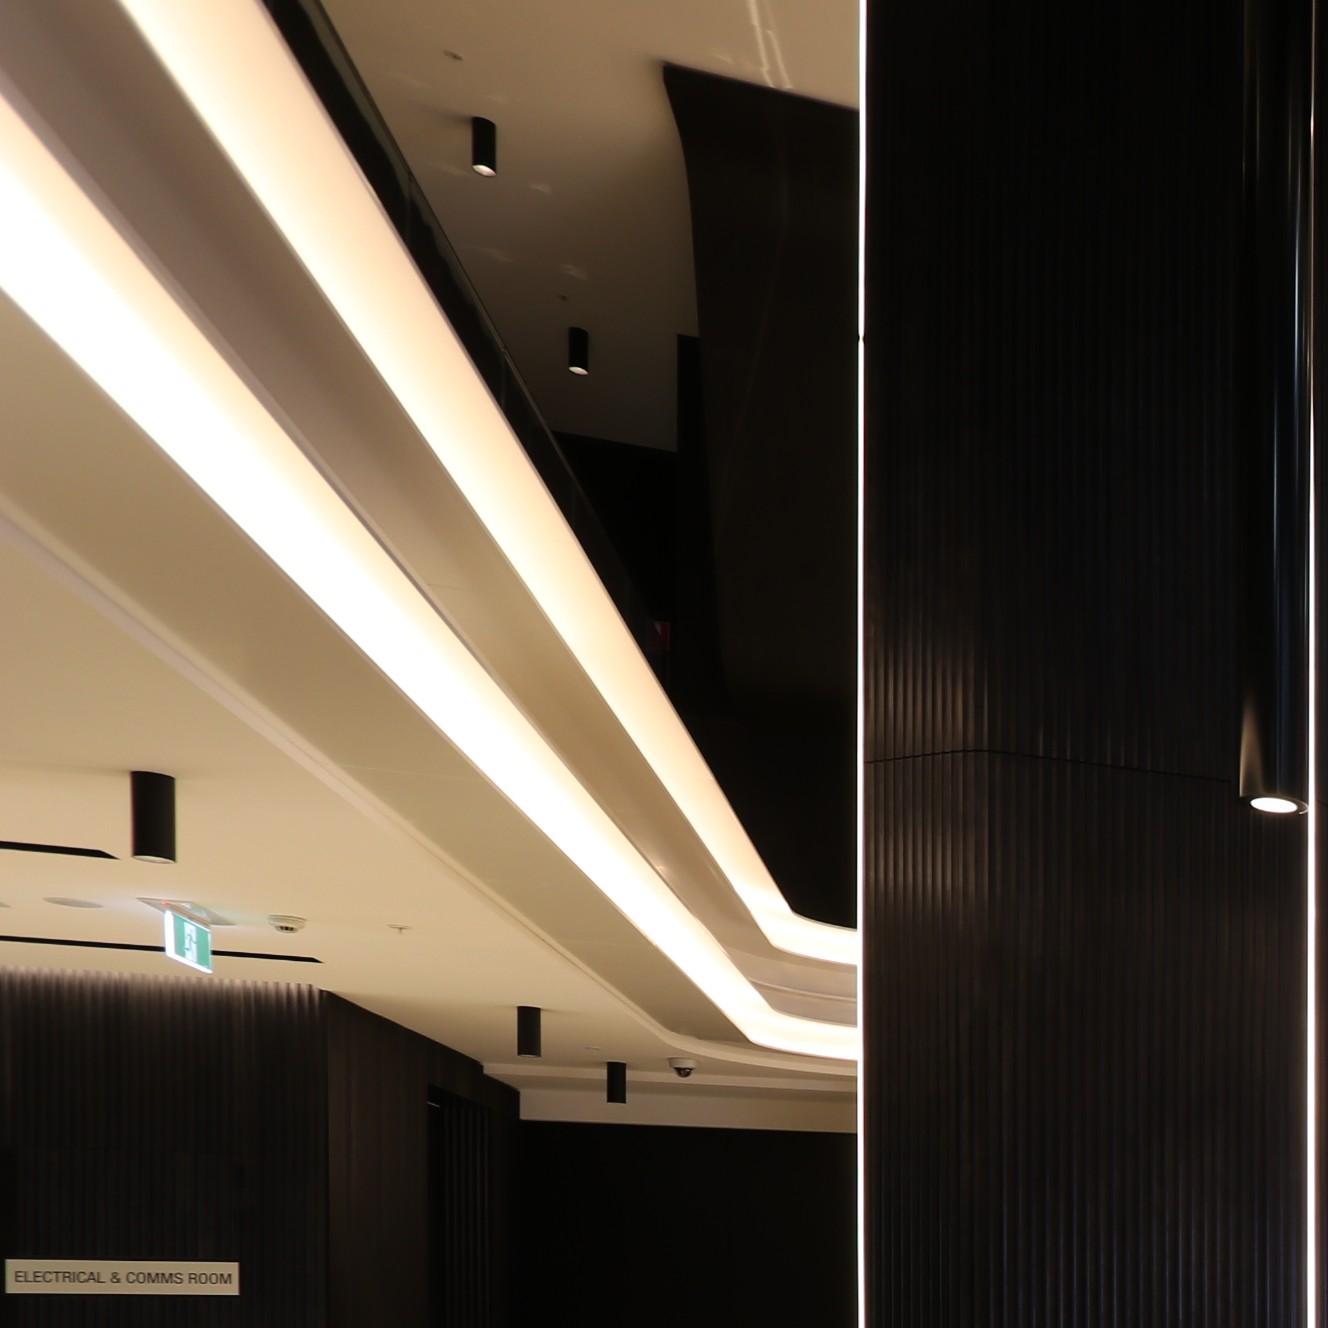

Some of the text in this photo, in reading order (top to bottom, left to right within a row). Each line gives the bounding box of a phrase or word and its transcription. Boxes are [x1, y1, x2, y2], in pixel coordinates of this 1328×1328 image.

[14, 1271, 232, 1285] ELECTRICAL & COMMS ROOM
